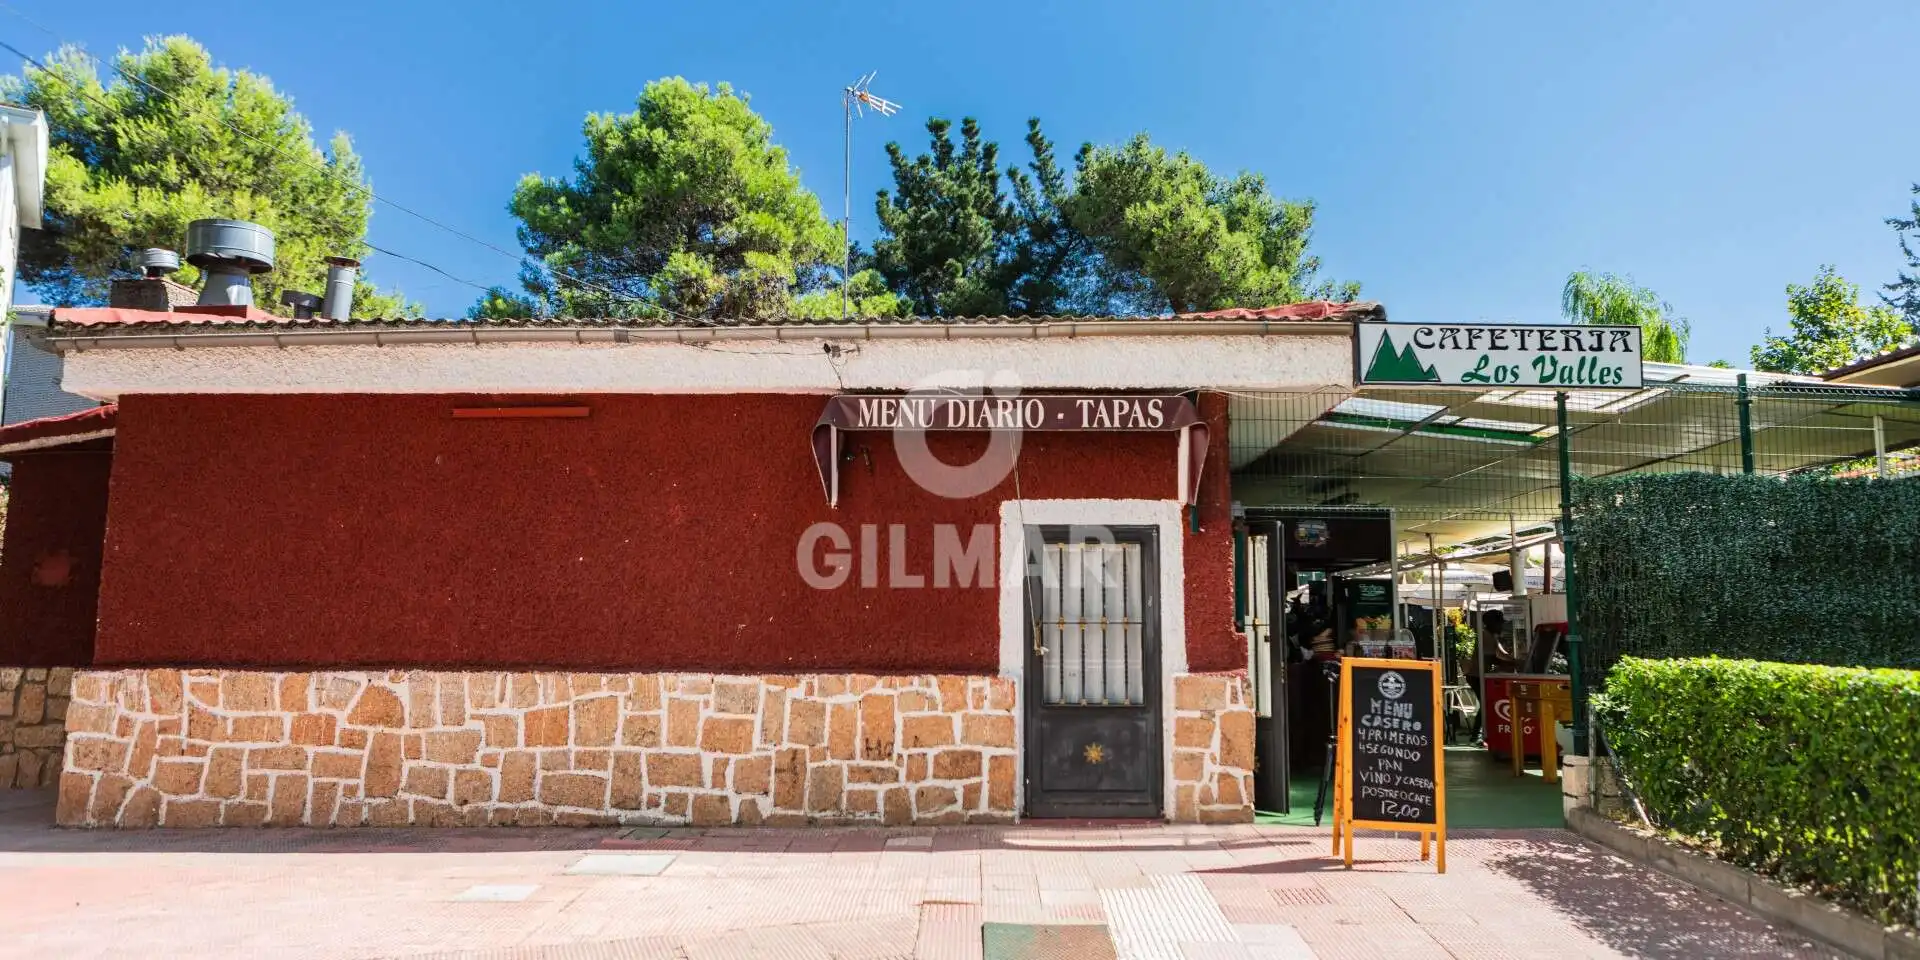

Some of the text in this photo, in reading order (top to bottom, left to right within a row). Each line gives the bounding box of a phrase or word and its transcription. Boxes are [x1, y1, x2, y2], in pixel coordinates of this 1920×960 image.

[1413, 327, 1633, 353] CAFETERIA
[1461, 354, 1623, 385] Los Valles
[858, 399, 1163, 428] MENU DIARIO TAPAS
[1370, 698, 1413, 719] MENU
[1361, 714, 1422, 731] CASERO
[1498, 724, 1532, 734] FRO
[1378, 758, 1403, 772] PAN
